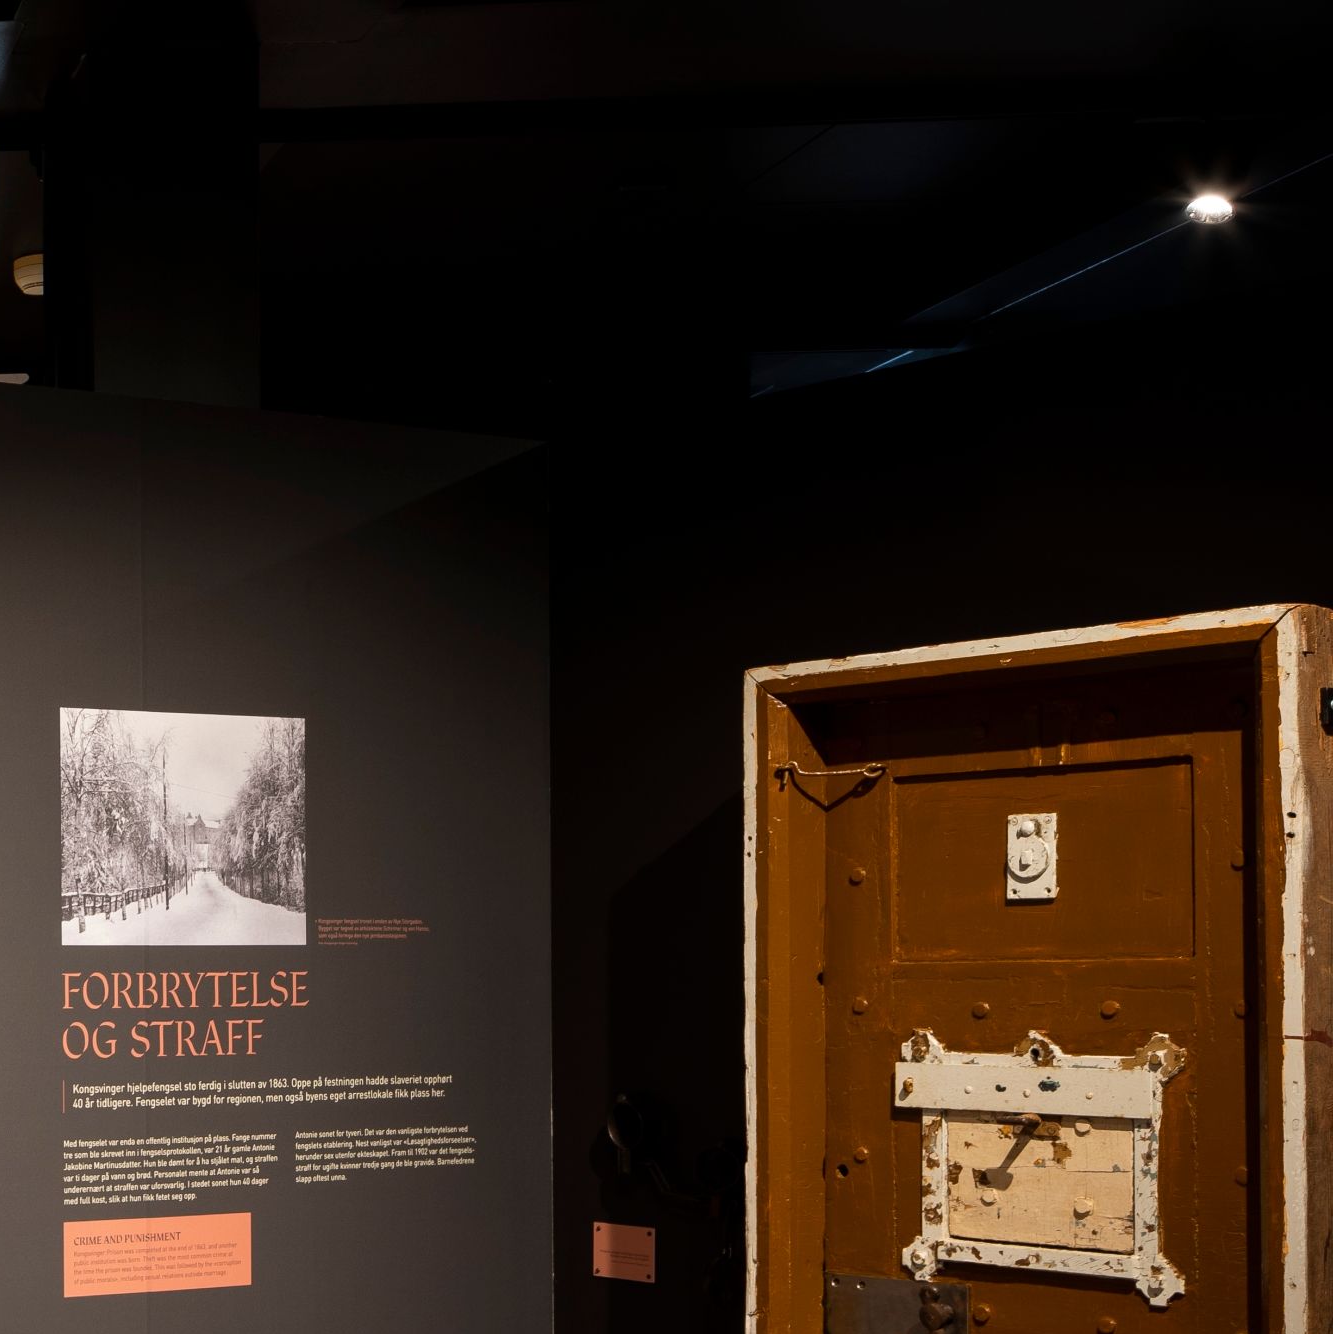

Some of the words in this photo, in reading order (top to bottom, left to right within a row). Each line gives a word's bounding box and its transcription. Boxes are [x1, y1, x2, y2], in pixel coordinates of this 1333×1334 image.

[62, 971, 308, 1009] FORBRYTELSE
[62, 1021, 116, 1059] OG
[130, 1019, 263, 1058] STRAFF
[72, 1098, 83, 1109] 40
[84, 1097, 94, 1108] år
[96, 1097, 133, 1110] tidligere.
[135, 1096, 175, 1109] Fengselet
[176, 1097, 190, 1106] var
[192, 1094, 211, 1107] bygd
[212, 1094, 225, 1104] for
[226, 1093, 264, 1106] regionen,
[265, 1094, 283, 1102] men
[284, 1090, 303, 1104] også
[305, 1091, 328, 1103] byens
[329, 1091, 346, 1103] eget
[347, 1088, 393, 1100] arrestlokale
[394, 1088, 409, 1098] fikk
[410, 1088, 430, 1100] plass
[431, 1087, 445, 1097] her.
[73, 1235, 102, 1246] CRIME
[105, 1234, 123, 1244] AND
[124, 1231, 181, 1243] PUNISHMENT
